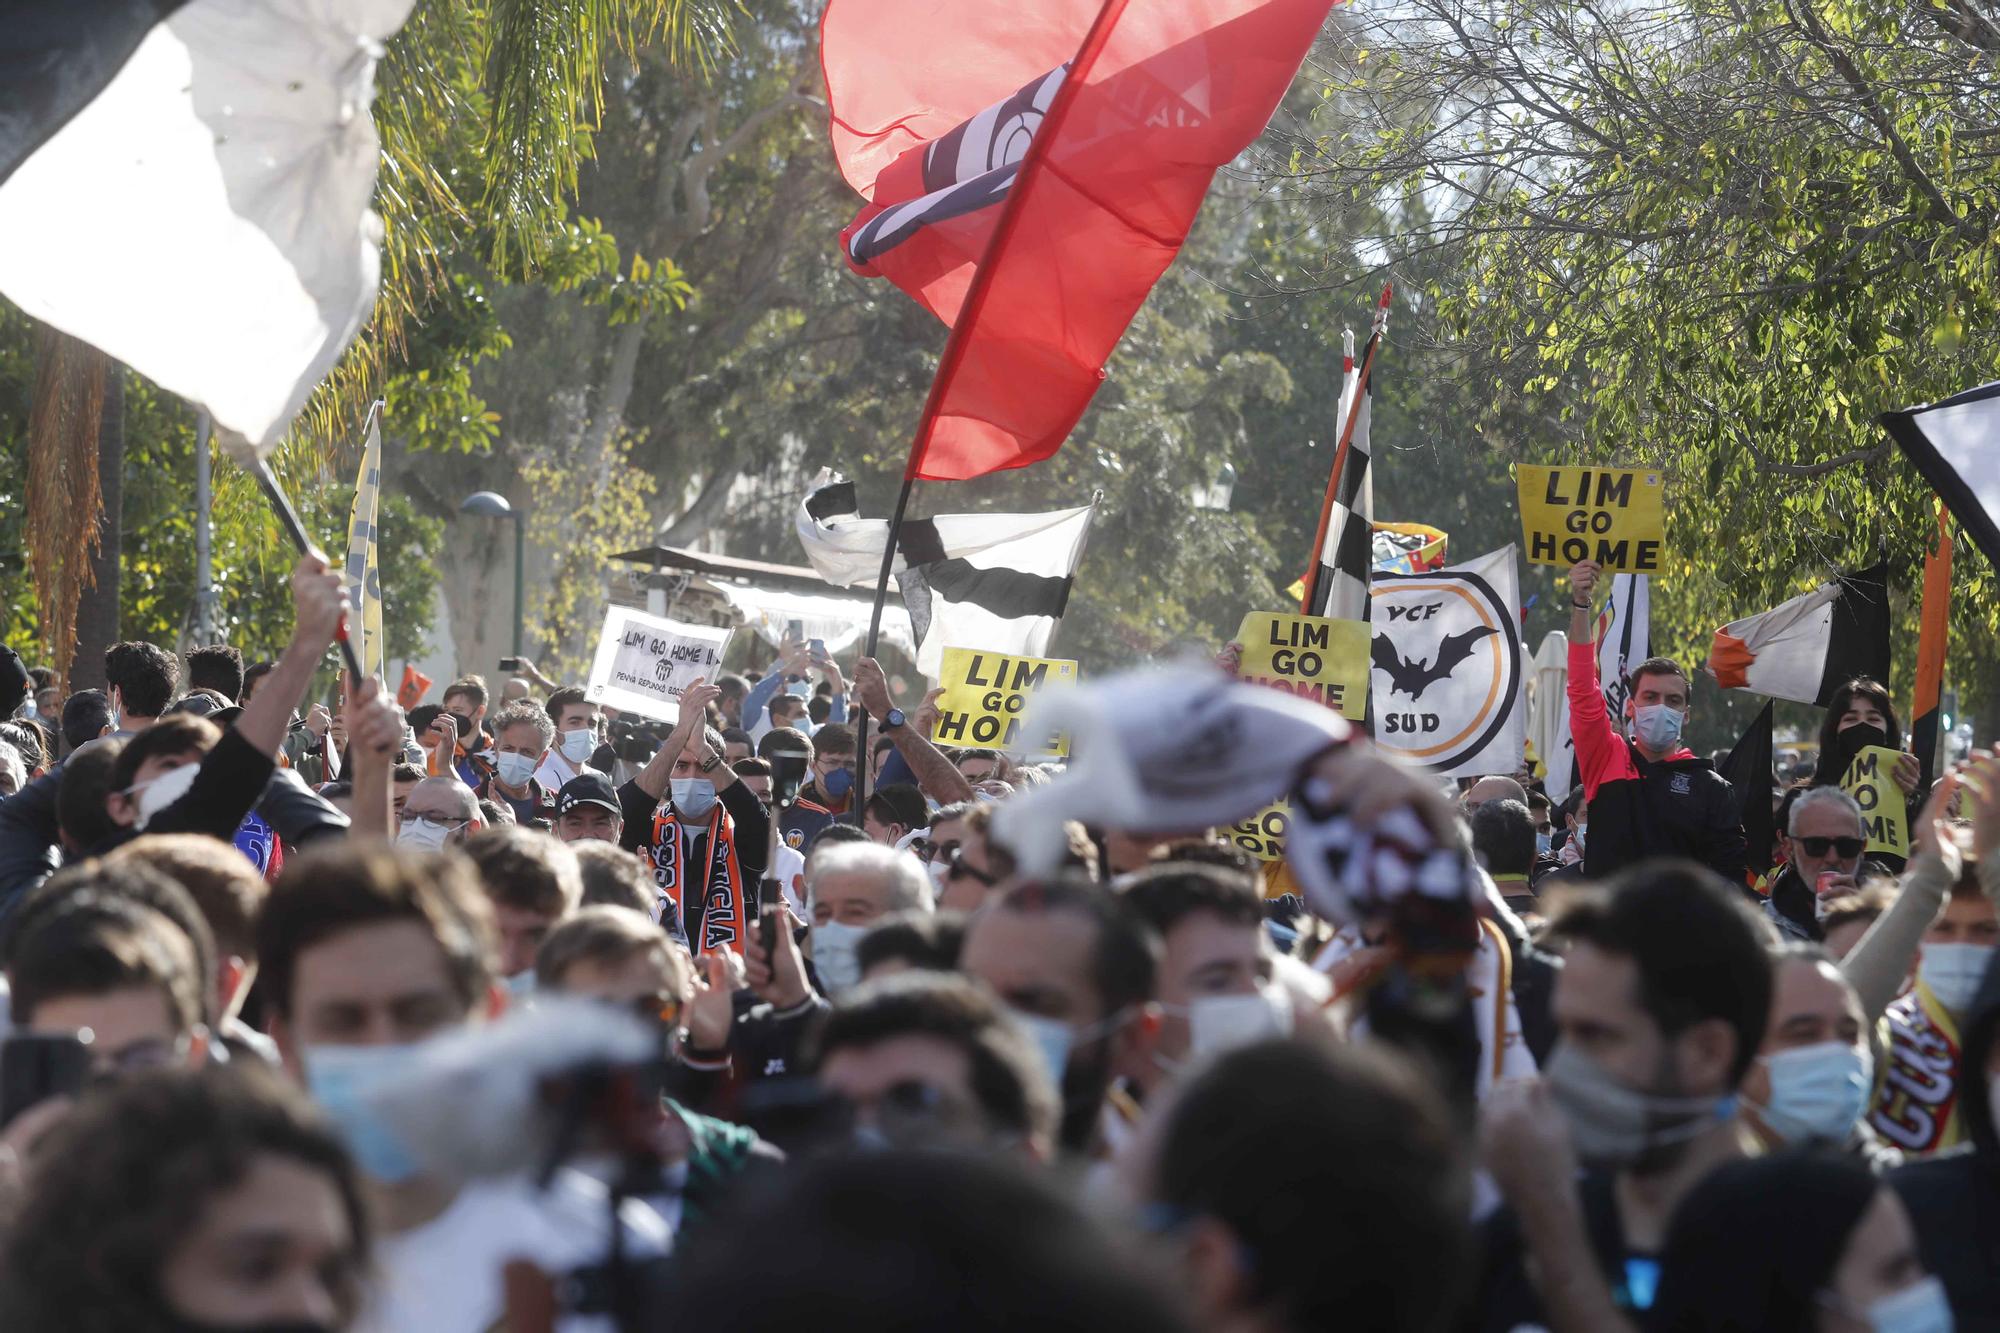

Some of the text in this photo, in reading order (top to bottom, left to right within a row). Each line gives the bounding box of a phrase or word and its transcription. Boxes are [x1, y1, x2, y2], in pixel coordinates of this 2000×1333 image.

[1545, 471, 1633, 508] LIM
[1566, 510, 1613, 534] GO
[1531, 531, 1660, 569] HOME
[1386, 602, 1443, 622] VCF
[624, 630, 646, 649] LIM
[650, 638, 666, 656] GO
[670, 644, 702, 663] HOME
[1270, 620, 1330, 650] LIM
[966, 655, 1049, 693] LIM
[1272, 650, 1323, 678] GO
[982, 691, 1026, 714] GO
[1385, 712, 1440, 734] SUD
